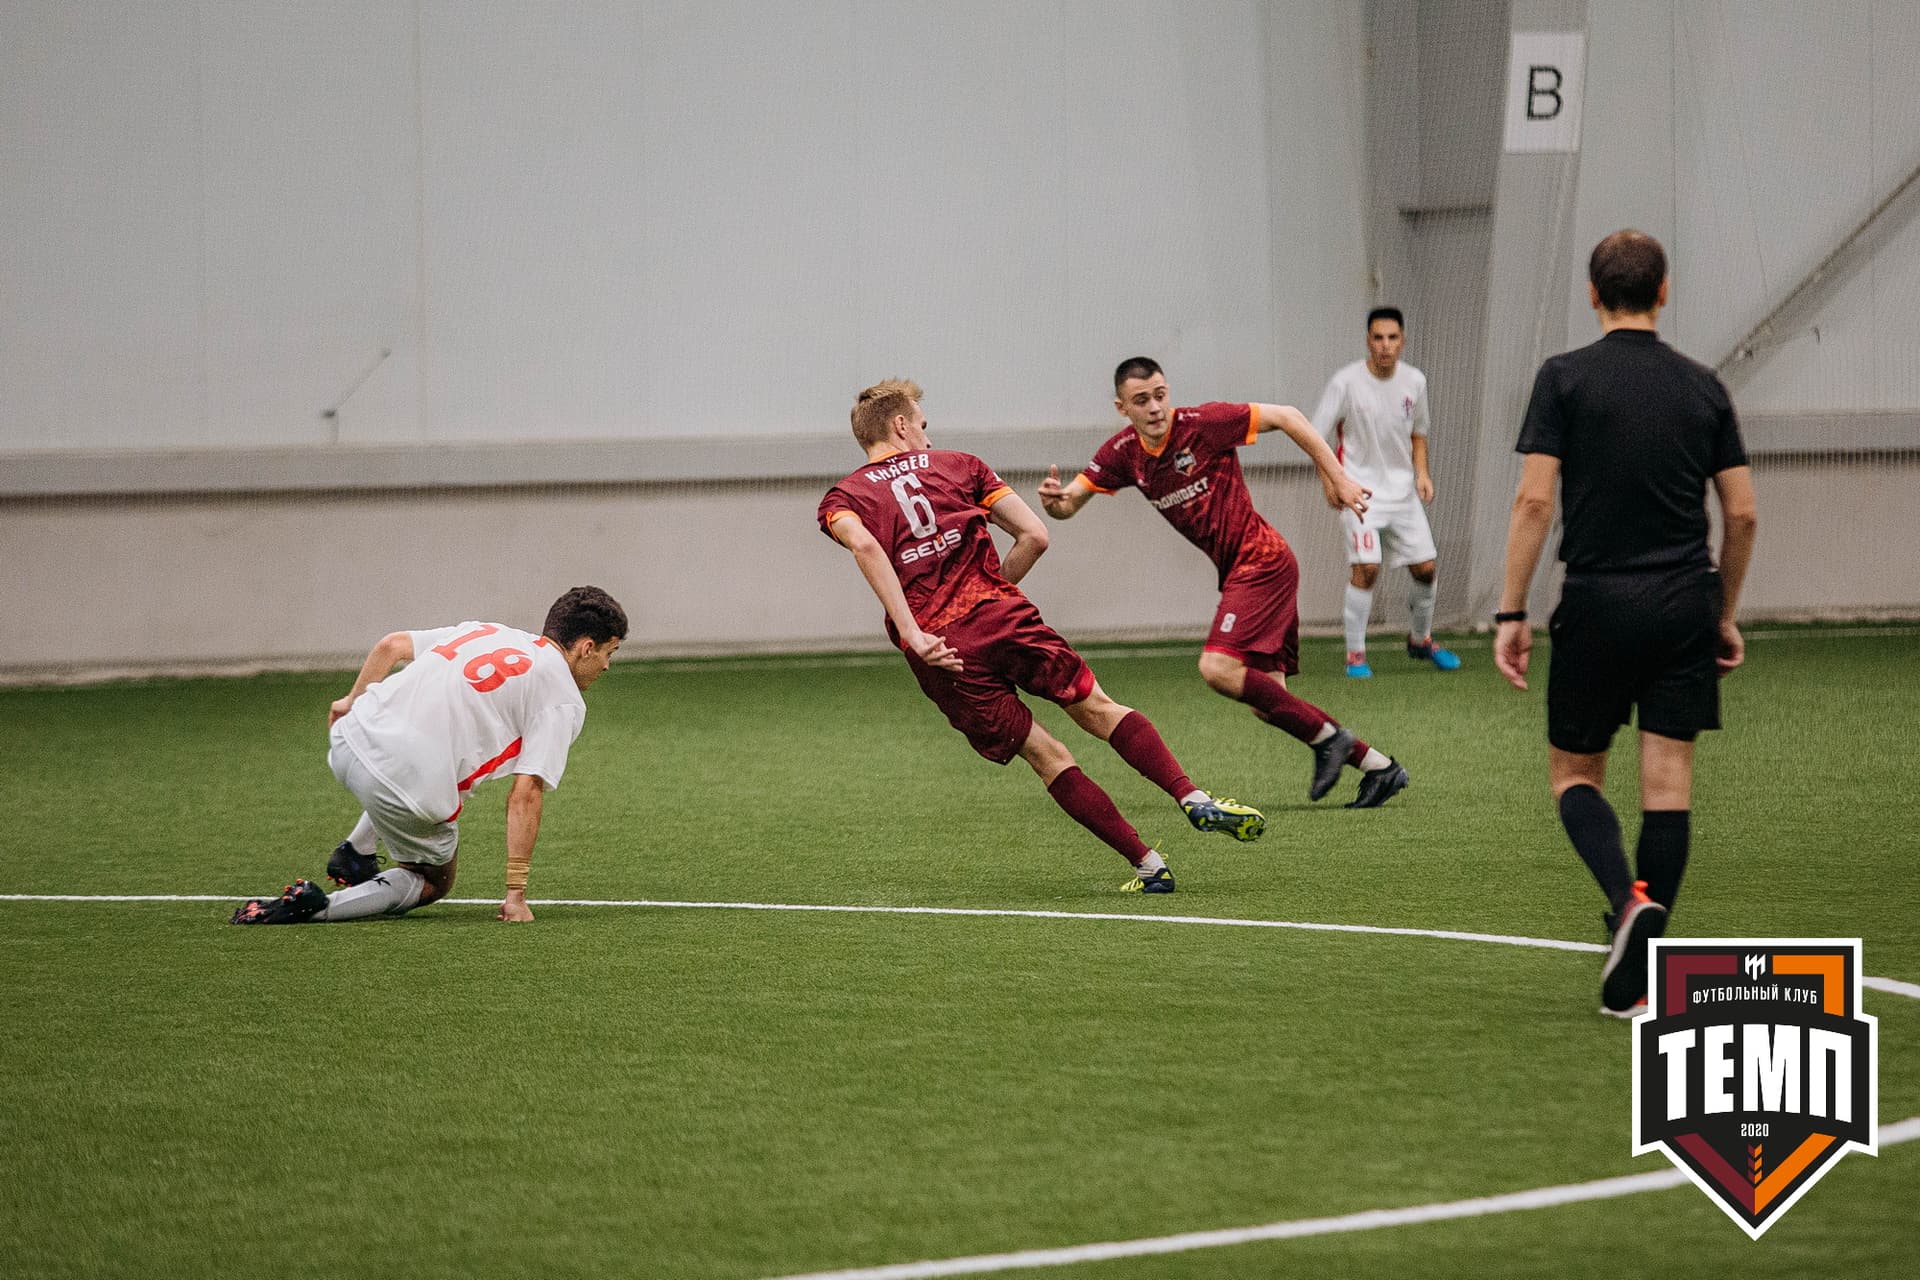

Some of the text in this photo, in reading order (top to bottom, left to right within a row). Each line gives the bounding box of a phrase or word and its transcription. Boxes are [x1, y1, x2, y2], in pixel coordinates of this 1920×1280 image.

[1527, 65, 1563, 120] B
[864, 453, 930, 483] КНЯЗЕВ
[891, 472, 938, 539] 6
[901, 528, 962, 564] SEUS
[1219, 612, 1237, 633] 8
[431, 623, 534, 694] 18
